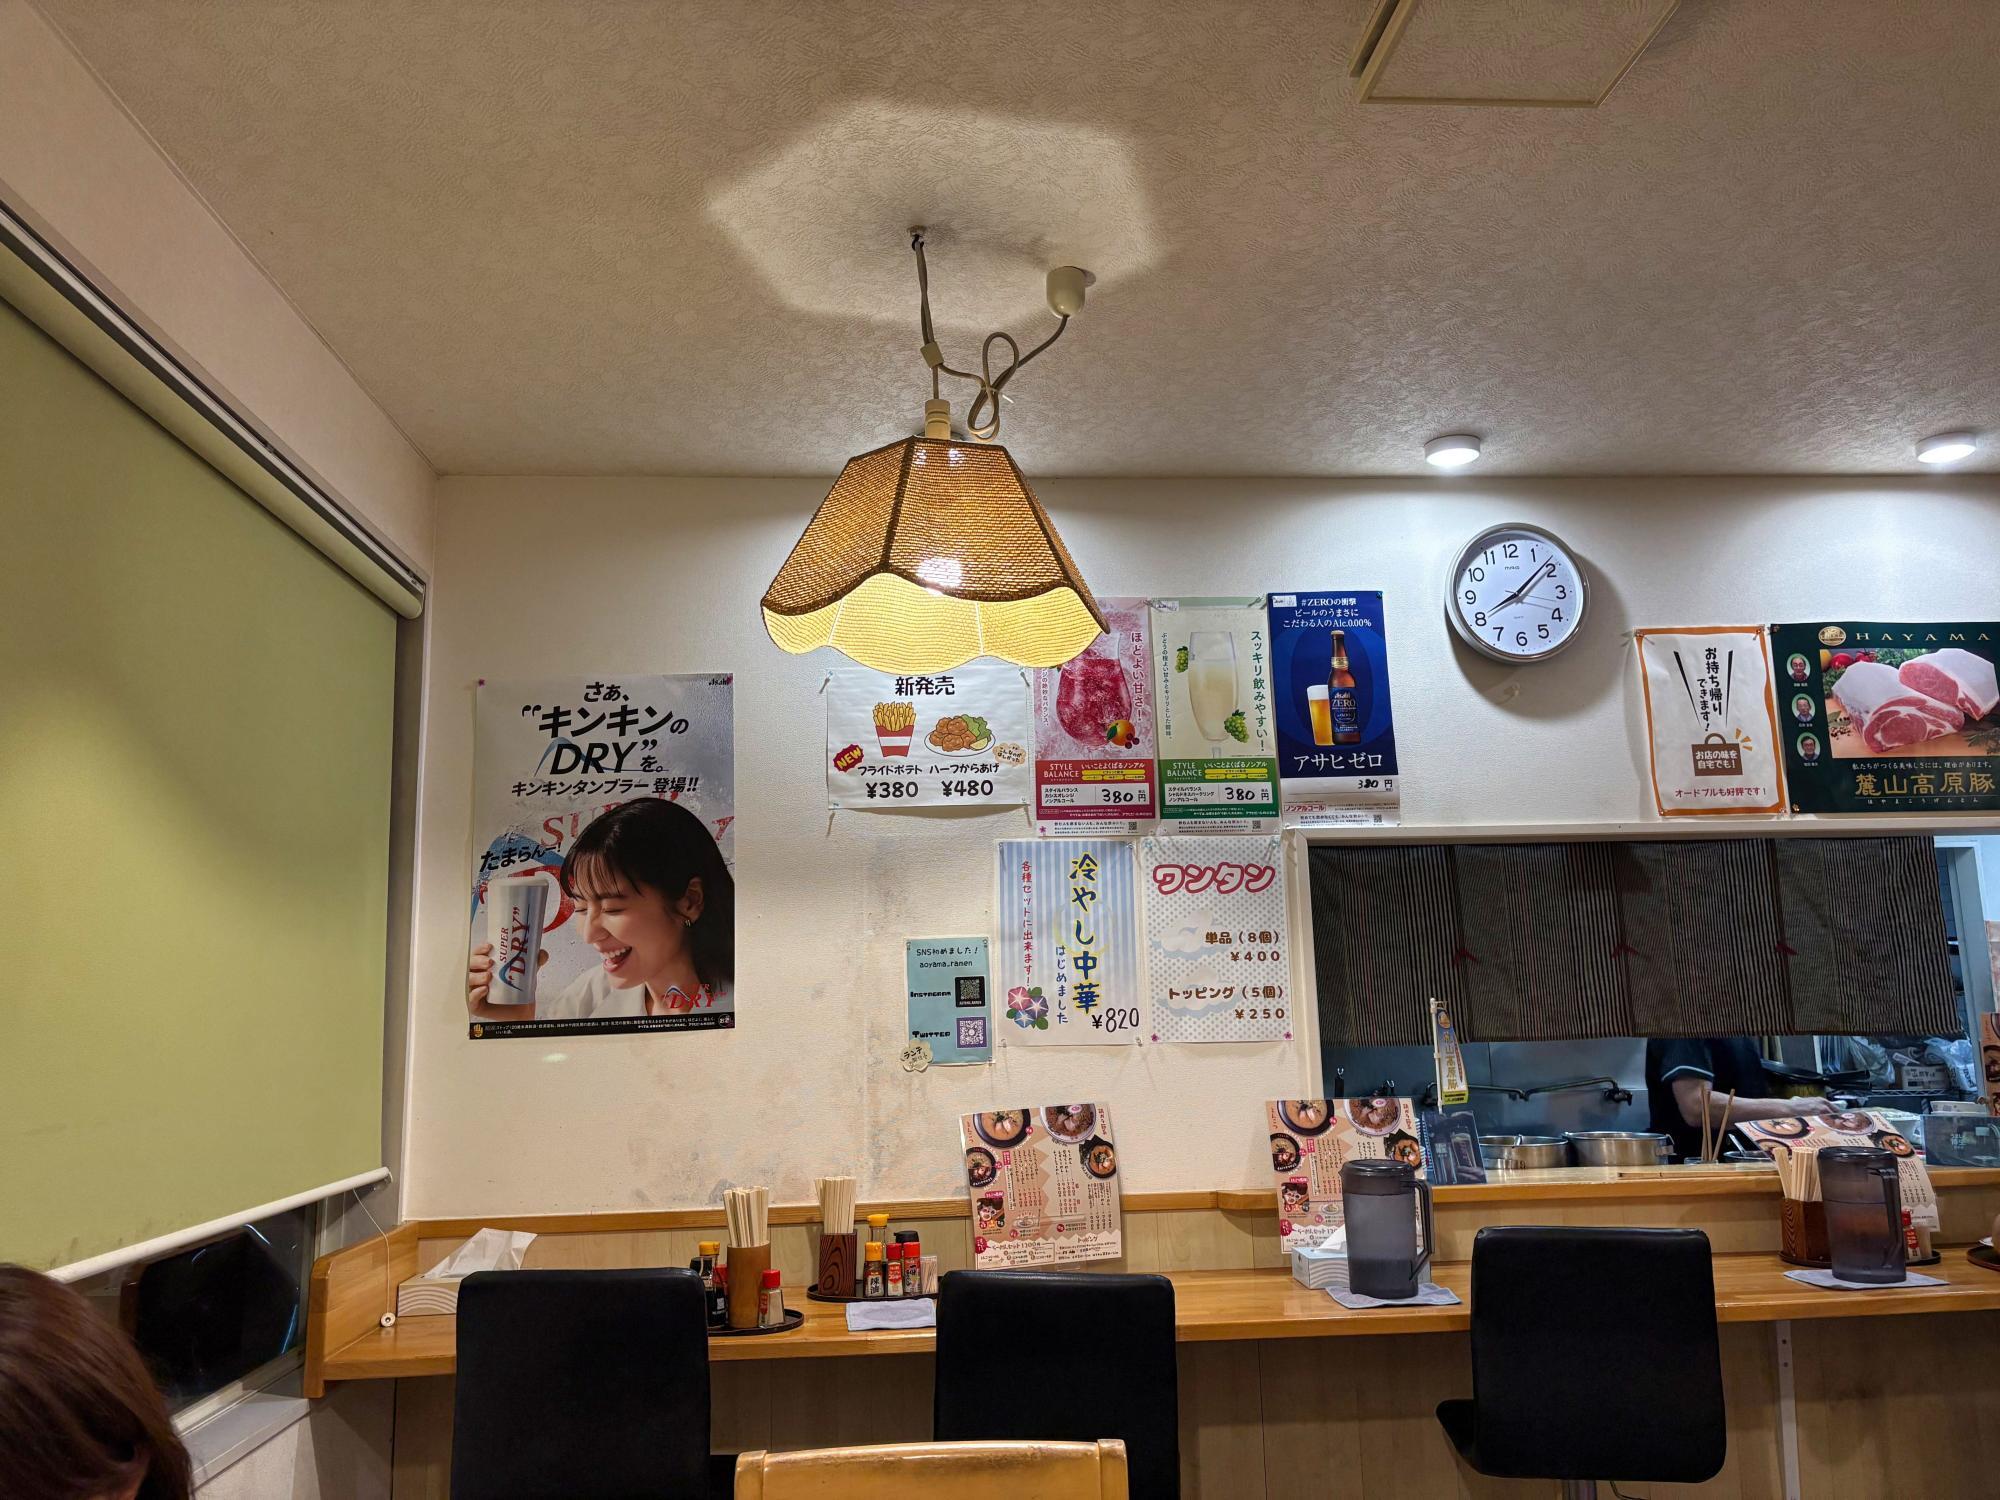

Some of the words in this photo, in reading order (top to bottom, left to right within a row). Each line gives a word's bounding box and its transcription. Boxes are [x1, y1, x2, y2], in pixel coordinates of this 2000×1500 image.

[1483, 550, 1496, 565] 11
[1502, 543, 1519, 559] 12
[1530, 548, 1536, 562] 1
[1468, 567, 1485, 583] 10
[1545, 563, 1557, 578] 2
[1464, 589, 1477, 605] 9
[1555, 584, 1567, 600] 3
[1295, 608, 1359, 617] ビールのうまさに
[1474, 611, 1487, 626] 8
[1551, 607, 1564, 622] 4
[1492, 626, 1505, 642] 7
[1516, 631, 1528, 647] 6
[1537, 623, 1550, 639] 5
[1855, 632, 1991, 641] HAYAMA
[895, 676, 956, 697] 新発売
[1704, 647, 1723, 716] お持ち帰り
[584, 681, 631, 702] さあ、
[1251, 631, 1268, 752] スッキリ飲みやすい!
[1697, 678, 1711, 732] できます!
[836, 746, 863, 769] NEW
[1293, 753, 1345, 772] アサヒ
[1348, 751, 1382, 769] ゼロ
[1695, 750, 1738, 760] お店の味を
[857, 764, 923, 777] フライドポテト
[929, 762, 1000, 775] ハーフからあげ
[1050, 763, 1073, 771] STYLE
[1697, 760, 1736, 769] 自宅でも!
[1043, 770, 1080, 778] BALANCE
[1167, 769, 1203, 777] BALANCE
[511, 779, 649, 797] キンキンタンブラー
[865, 781, 919, 799] ¥380
[941, 779, 994, 797] ¥480
[1384, 779, 1393, 788] 円
[1854, 772, 1996, 797] 麓山高原豚
[1101, 788, 1134, 804] 380
[1138, 793, 1146, 802] 円
[1225, 787, 1255, 800] 380
[1261, 792, 1270, 801] 円
[1675, 787, 1767, 798] オードブルも好評です!
[1285, 804, 1325, 812] ノンアルコール
[1152, 861, 1276, 895] ワンタン
[1069, 852, 1100, 1015] 冷やし中華
[499, 927, 509, 963] SUPER
[1230, 951, 1280, 962] ¥400
[1055, 945, 1068, 1025] はじめました
[1091, 1007, 1140, 1033] ¥820
[1234, 1008, 1285, 1020] ¥250
